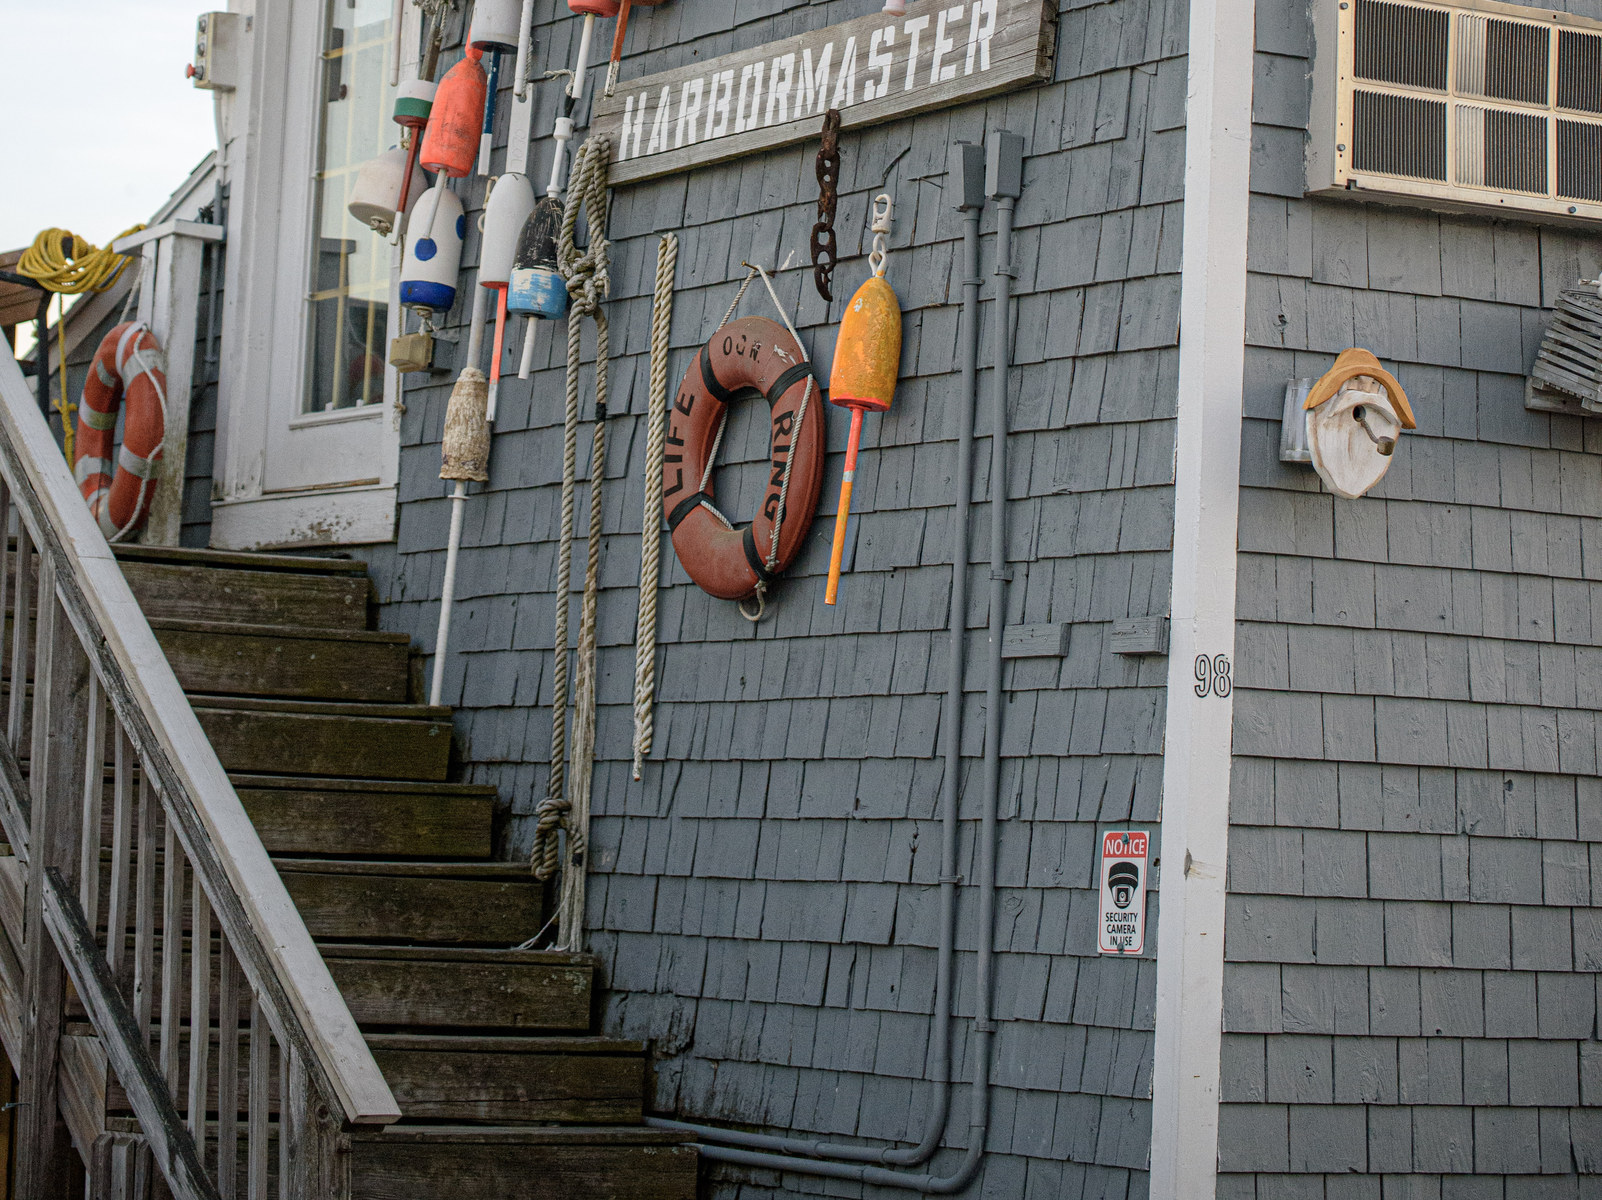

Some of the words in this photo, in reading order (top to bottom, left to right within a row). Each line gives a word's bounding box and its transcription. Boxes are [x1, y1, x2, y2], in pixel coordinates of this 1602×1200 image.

[663, 392, 696, 498] LIFE
[764, 410, 794, 524] RING
[1194, 653, 1232, 698] 98
[1105, 838, 1145, 855] NOTICE
[1105, 912, 1138, 923] SECURITY
[1106, 924, 1136, 935] CAMERA
[1109, 936, 1118, 946] IN
[1119, 936, 1132, 946] USE
